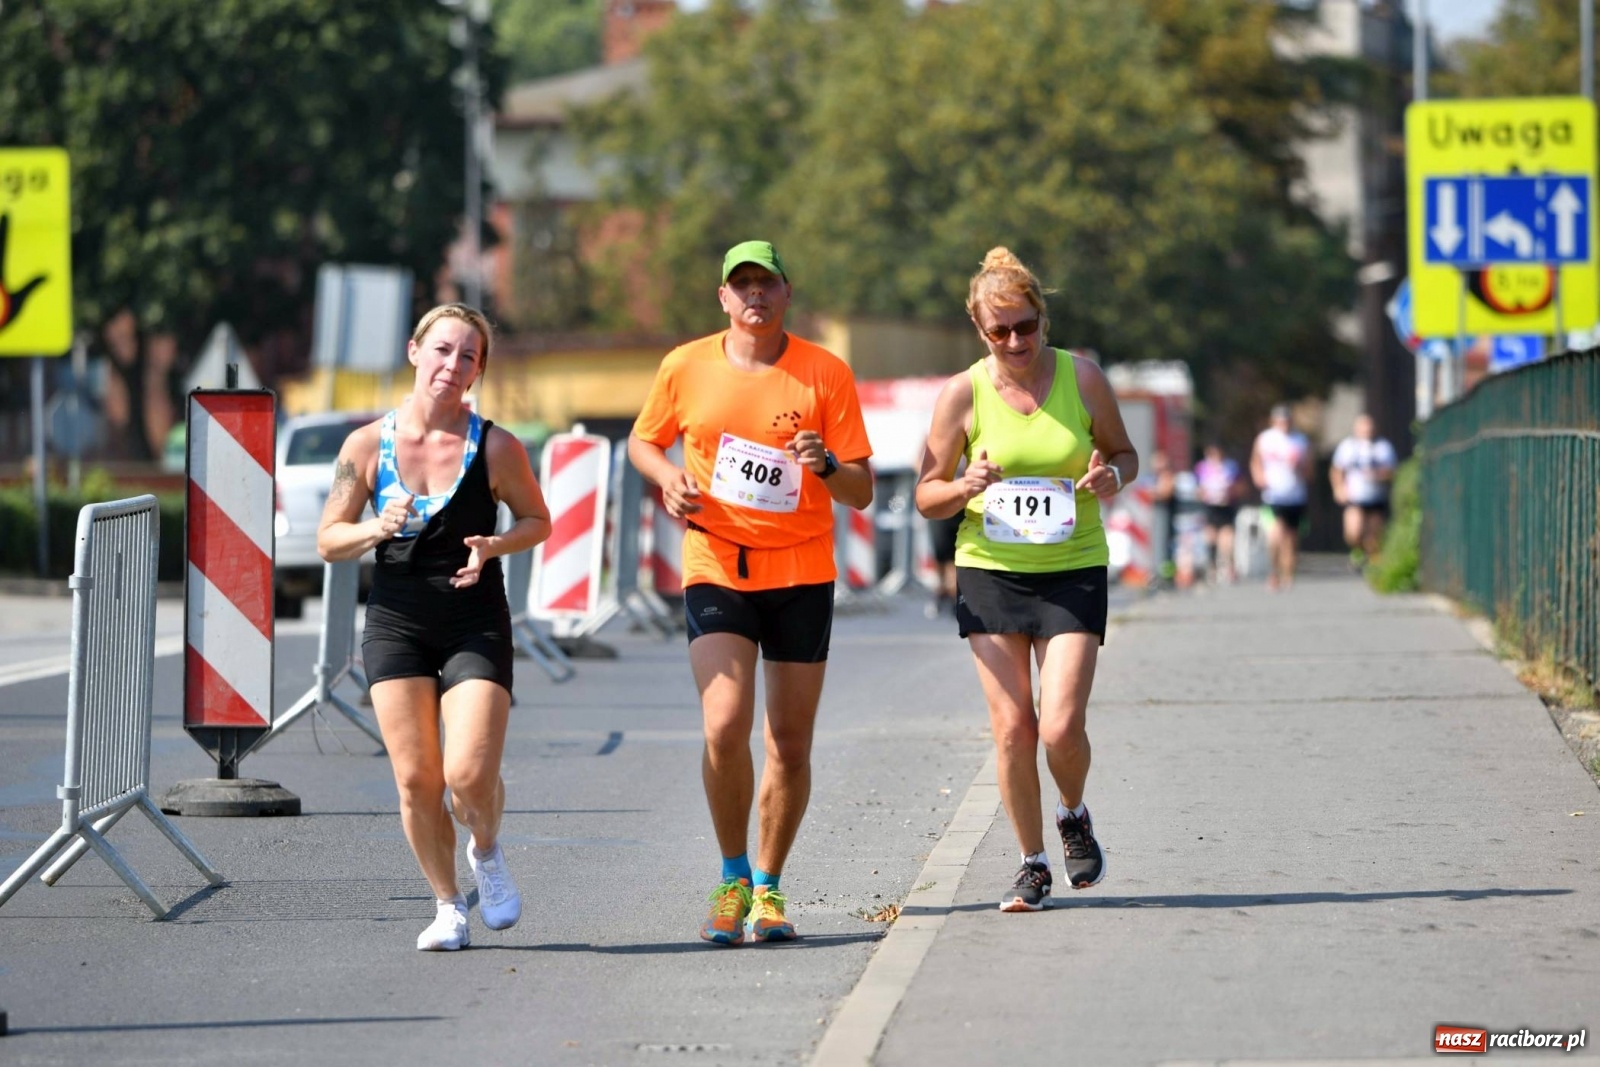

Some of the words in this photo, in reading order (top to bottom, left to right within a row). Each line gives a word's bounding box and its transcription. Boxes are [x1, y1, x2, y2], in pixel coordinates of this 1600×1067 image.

[1427, 112, 1573, 157] Uwaga
[0, 167, 49, 202] ga
[740, 459, 783, 487] 408
[1013, 495, 1051, 517] 191
